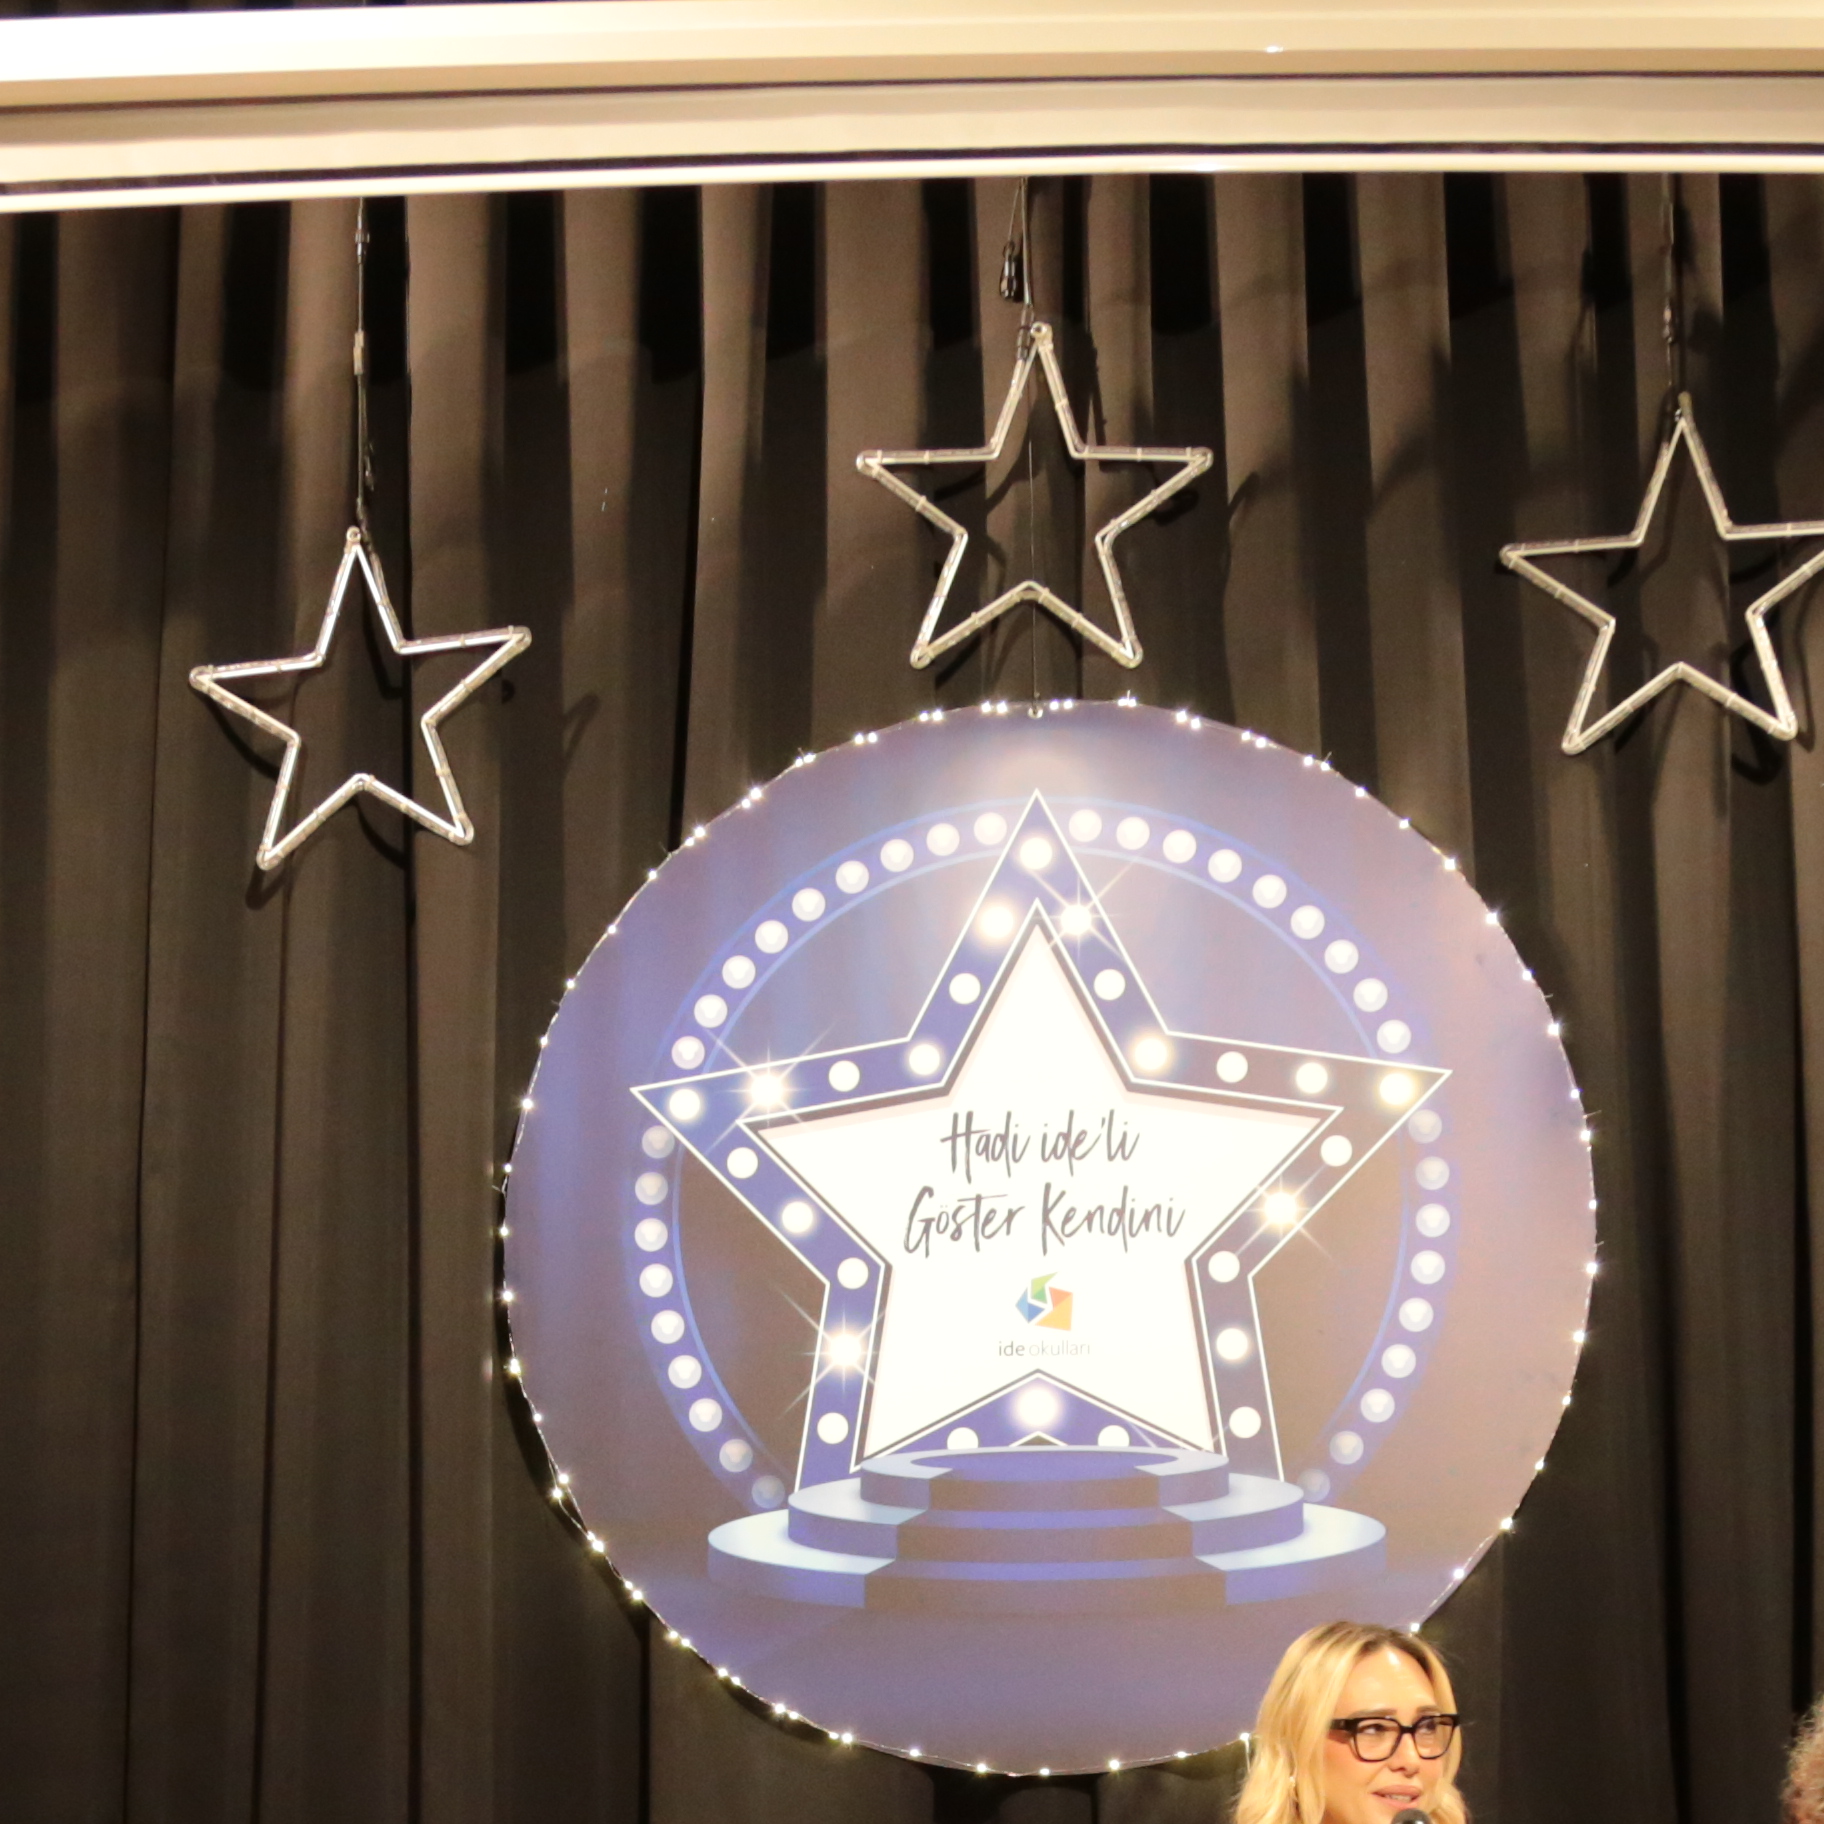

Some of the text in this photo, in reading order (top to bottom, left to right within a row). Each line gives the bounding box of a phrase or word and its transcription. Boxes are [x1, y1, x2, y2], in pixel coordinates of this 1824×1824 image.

[940, 1109, 1140, 1184] Hadi ide'li
[903, 1182, 1185, 1258] Göster Kendini
[998, 1340, 1091, 1357] ide okulları
